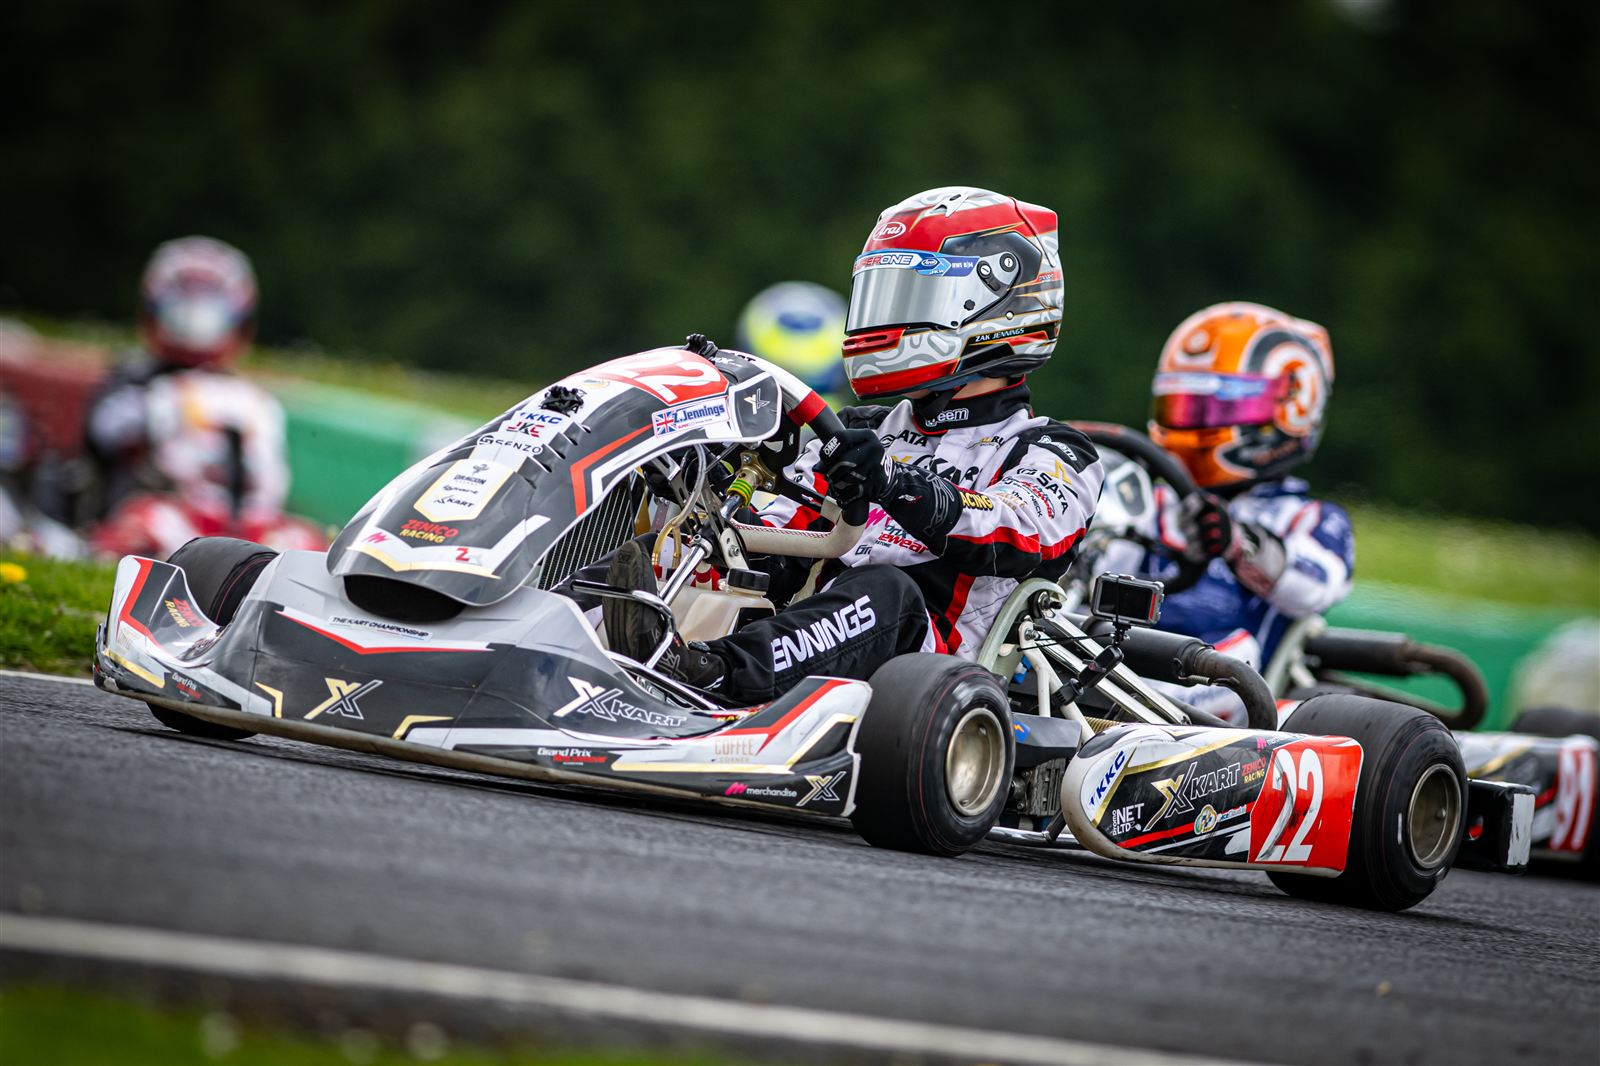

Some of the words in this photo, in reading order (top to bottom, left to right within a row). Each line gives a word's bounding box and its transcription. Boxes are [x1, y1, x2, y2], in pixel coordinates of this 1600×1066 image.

[880, 223, 902, 236] Arai
[975, 334, 990, 342] ZAK
[993, 328, 1025, 339] JENNINGS
[673, 404, 725, 424] Z.Jennings
[824, 437, 839, 456] OMP
[896, 430, 928, 447] ATA
[960, 492, 993, 511] ACING
[1036, 473, 1068, 514] SATA
[400, 528, 445, 543] RACING
[401, 519, 459, 538] ZENICO
[879, 532, 929, 554] ewear
[164, 600, 191, 628] RACING
[369, 622, 429, 637] CHAMPIONSHIP
[771, 595, 876, 673] ENNINGS
[611, 700, 687, 727] KART
[537, 747, 569, 756] Grand
[570, 748, 592, 757] Prix
[715, 738, 753, 756] COFFEE
[1242, 756, 1266, 777] ZENICO
[1244, 768, 1265, 784] RACING
[746, 786, 797, 797] merchandise
[1190, 763, 1240, 801] KART
[1116, 803, 1145, 825] NET
[1255, 748, 1323, 862] 22
[1117, 822, 1131, 834] LTD
